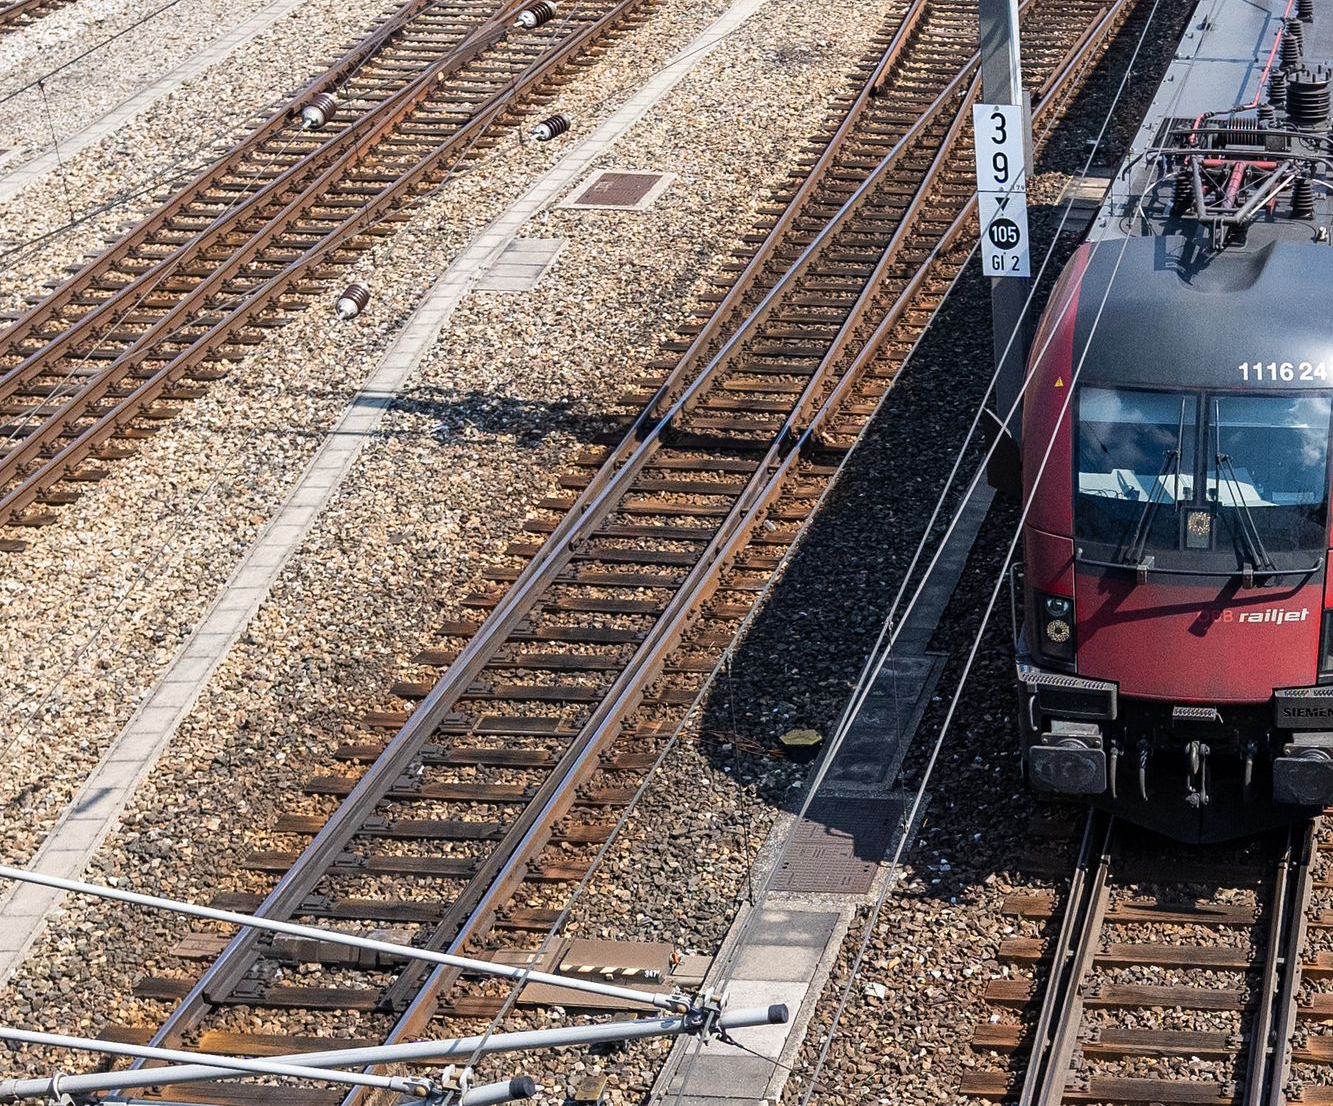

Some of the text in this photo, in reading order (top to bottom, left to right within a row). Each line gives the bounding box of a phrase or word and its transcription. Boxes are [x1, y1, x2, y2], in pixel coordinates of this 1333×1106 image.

[990, 112, 1007, 145] 3
[992, 151, 1009, 184] 9
[991, 225, 1017, 243] 105
[1011, 255, 1020, 271] 2
[1238, 361, 1294, 382] 1116
[1238, 607, 1310, 625] railjet
